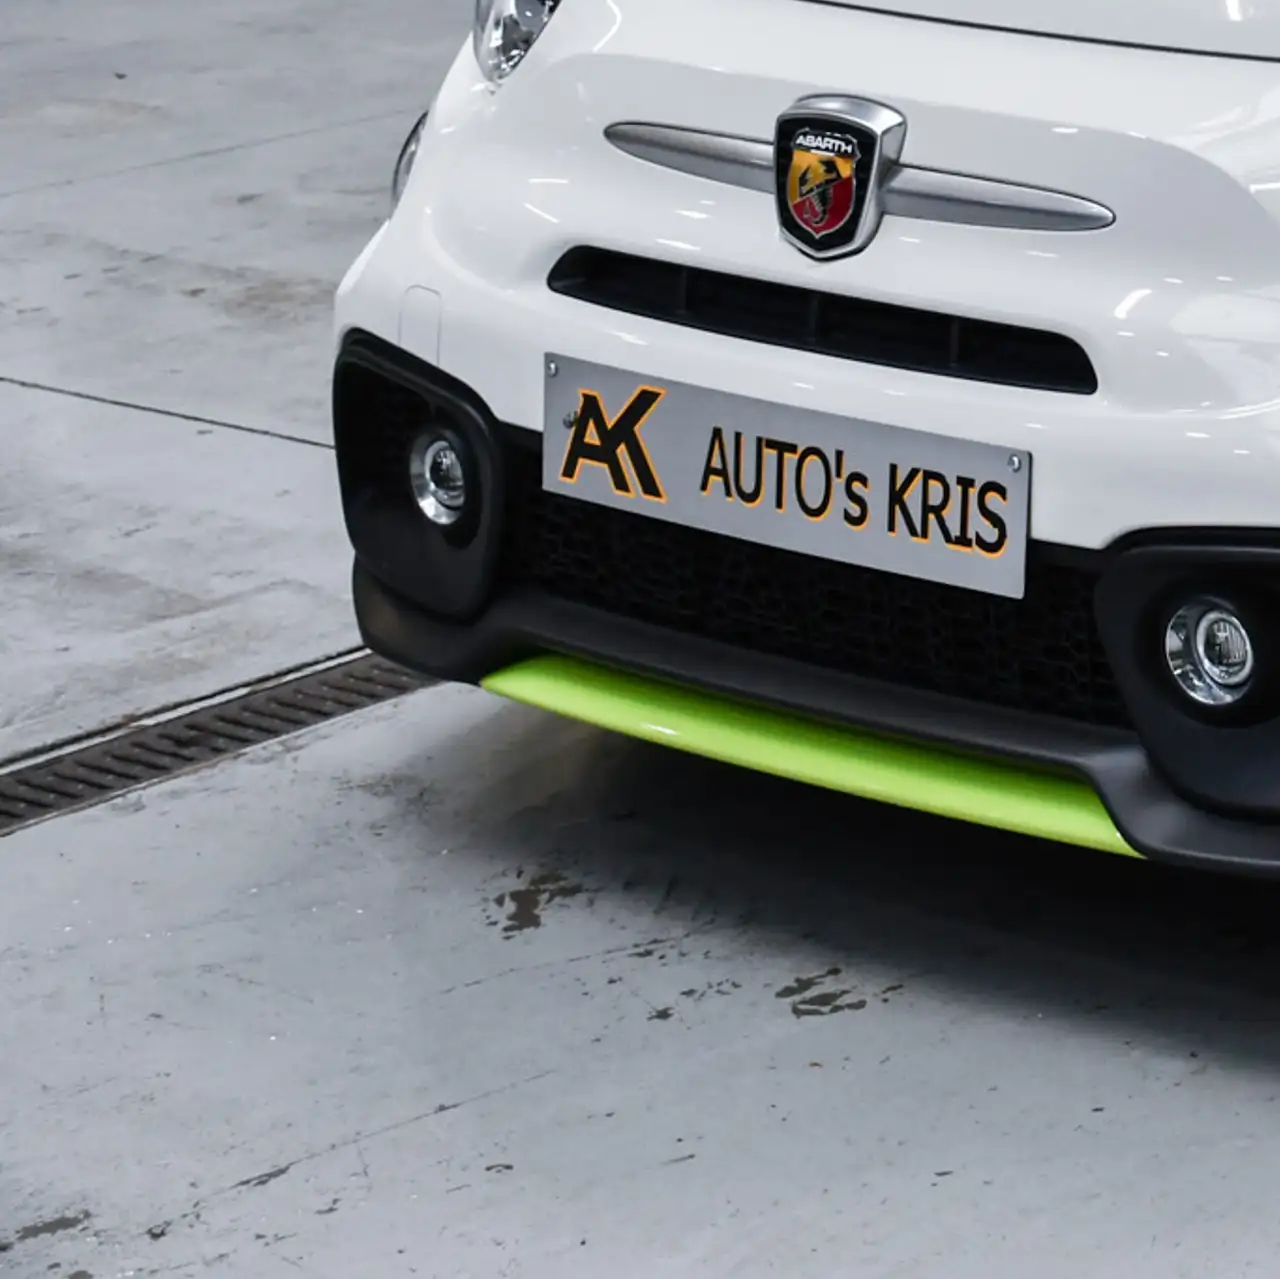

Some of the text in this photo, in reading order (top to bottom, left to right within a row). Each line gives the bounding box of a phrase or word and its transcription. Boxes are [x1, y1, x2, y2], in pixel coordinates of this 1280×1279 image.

[795, 134, 852, 153] ABARTH
[558, 384, 1009, 558] AK AUTO's KRIS
